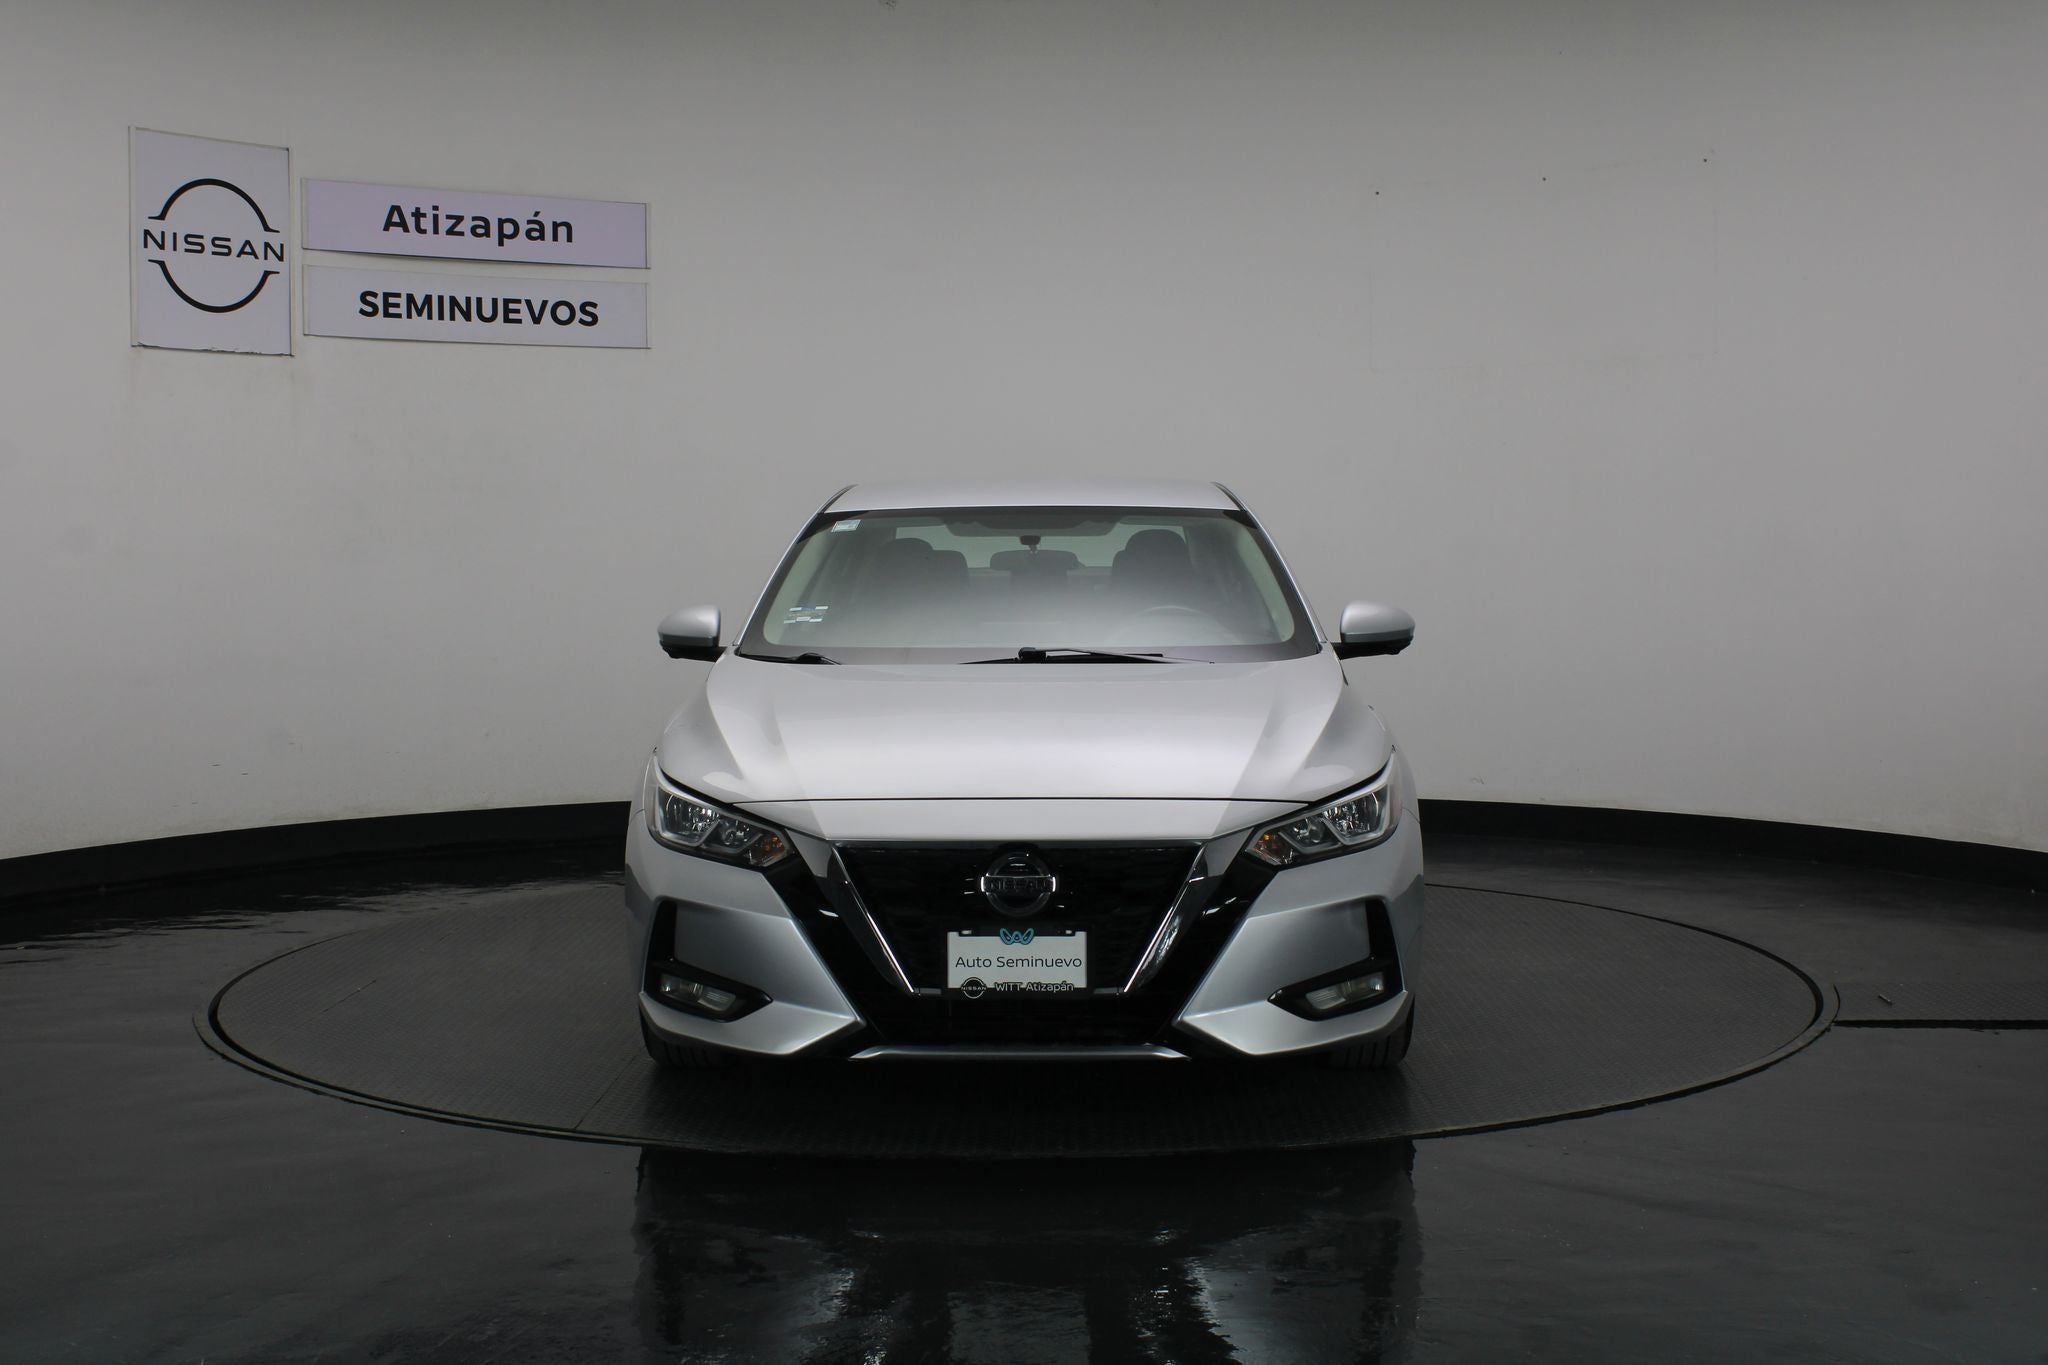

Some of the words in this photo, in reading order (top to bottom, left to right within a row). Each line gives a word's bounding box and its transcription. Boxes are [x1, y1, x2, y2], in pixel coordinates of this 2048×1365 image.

[383, 204, 574, 247] Atizapán
[143, 228, 285, 262] NISSAN
[358, 290, 599, 327] SEMINUEVOS
[955, 956, 992, 968] Auto
[996, 956, 1082, 968] Seminuevo
[995, 981, 1022, 992] WITT
[1026, 980, 1074, 993] Atizapán
